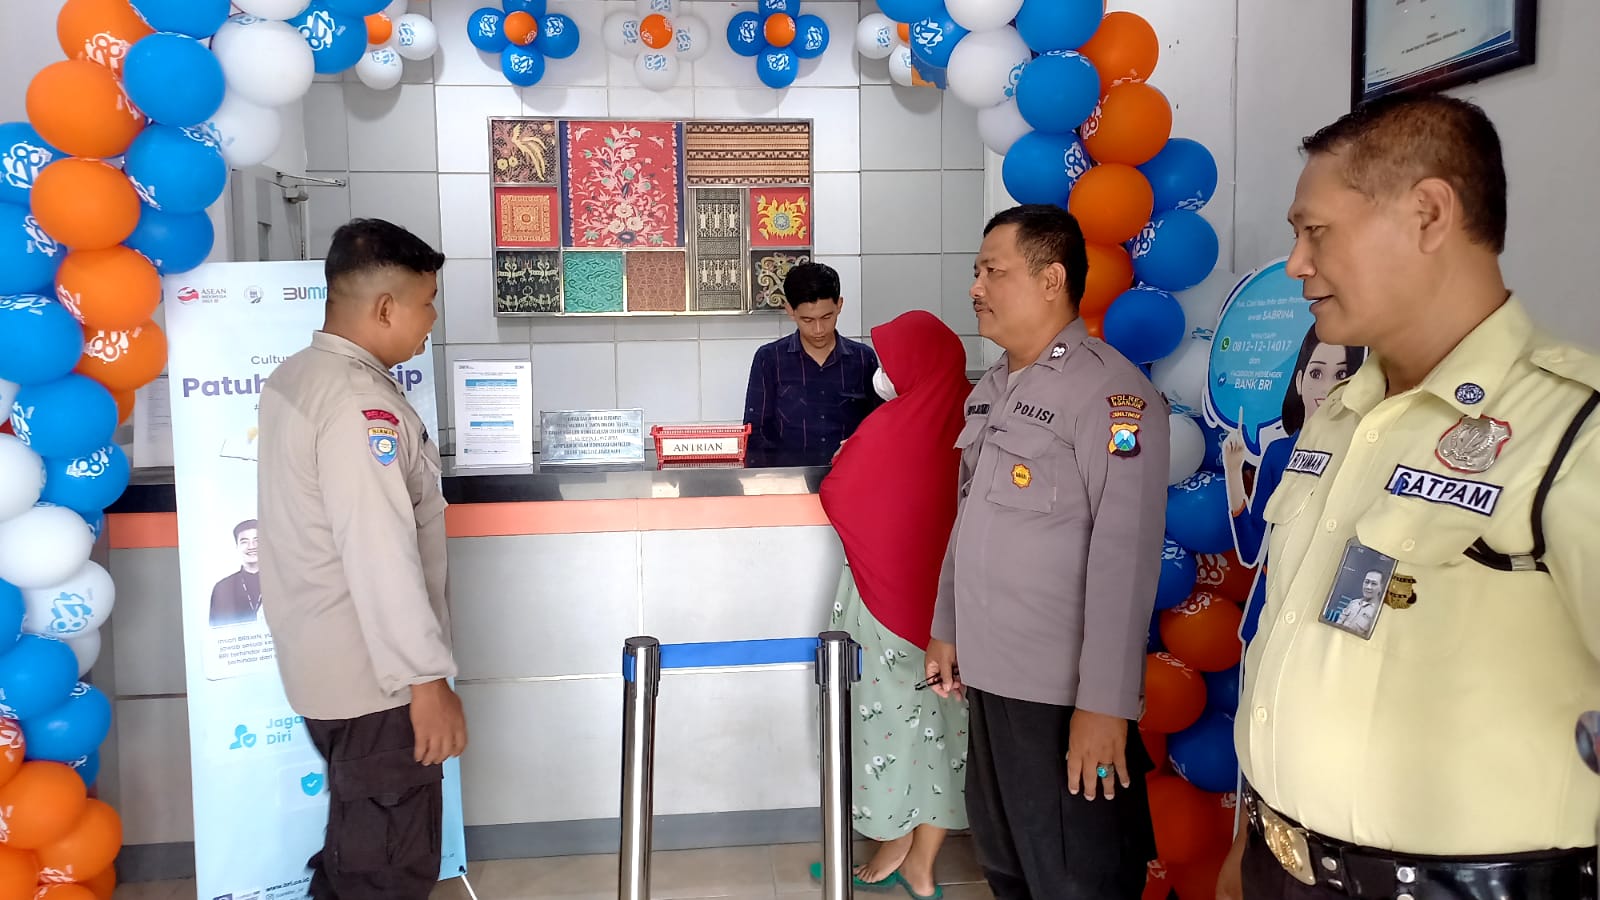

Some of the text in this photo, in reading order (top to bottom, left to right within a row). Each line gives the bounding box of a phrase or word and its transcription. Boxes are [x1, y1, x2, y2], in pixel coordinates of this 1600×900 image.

[1232, 340, 1292, 352] 0812-12-14017
[1234, 378, 1273, 391] BANK BRI
[1013, 401, 1055, 424] POLISI
[673, 442, 723, 452] ANTRIAN
[1398, 471, 1493, 510] SATPAM
[266, 716, 304, 729] Jaga
[267, 730, 292, 745] Diri
